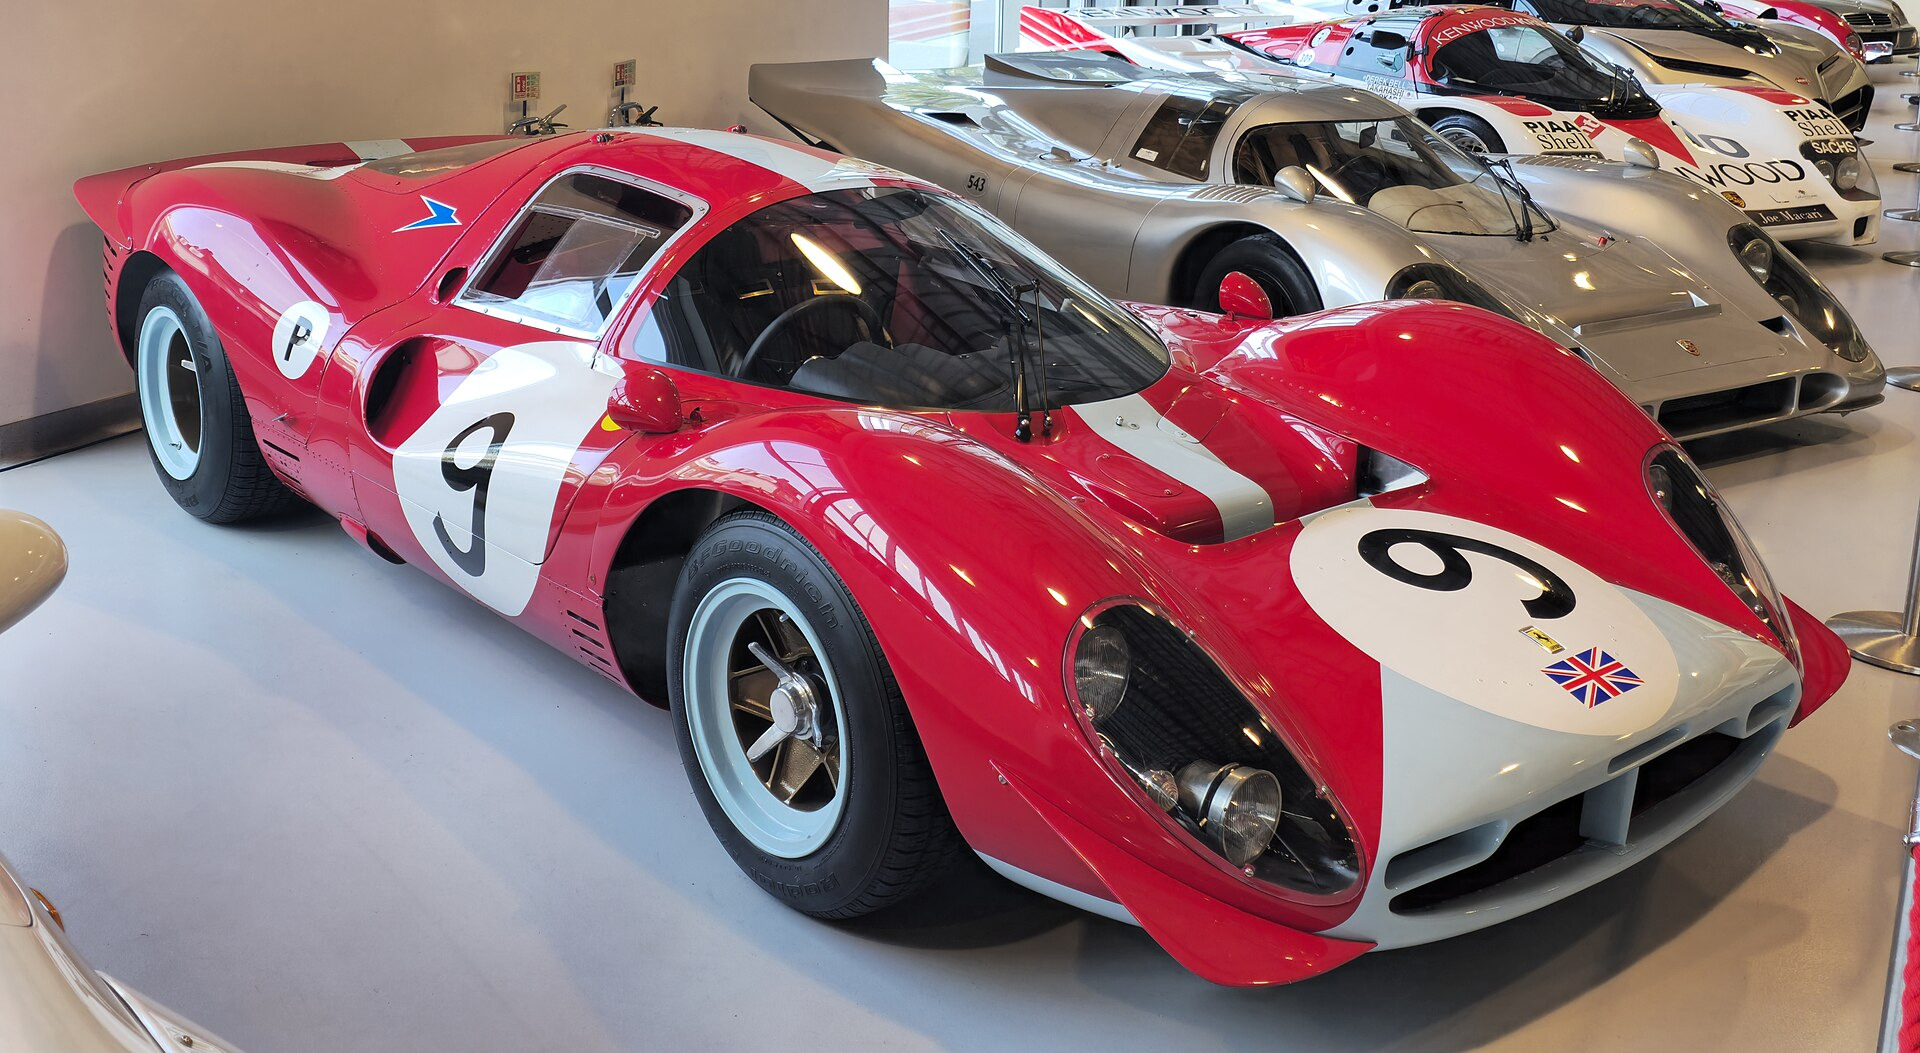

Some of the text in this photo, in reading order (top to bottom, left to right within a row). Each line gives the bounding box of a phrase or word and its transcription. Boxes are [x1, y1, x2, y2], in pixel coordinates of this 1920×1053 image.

[1432, 17, 1517, 45] KENWOOD
[1783, 108, 1836, 122] PIAA
[1522, 120, 1581, 133] PIAA
[1798, 119, 1851, 137] Shell
[1537, 133, 1594, 150] Shell
[1811, 141, 1857, 154] SACHS
[967, 175, 986, 192] 543
[1759, 208, 1823, 225] Joe Macari
[284, 315, 313, 362] P
[433, 411, 516, 577] 9
[1357, 528, 1577, 620] 9
